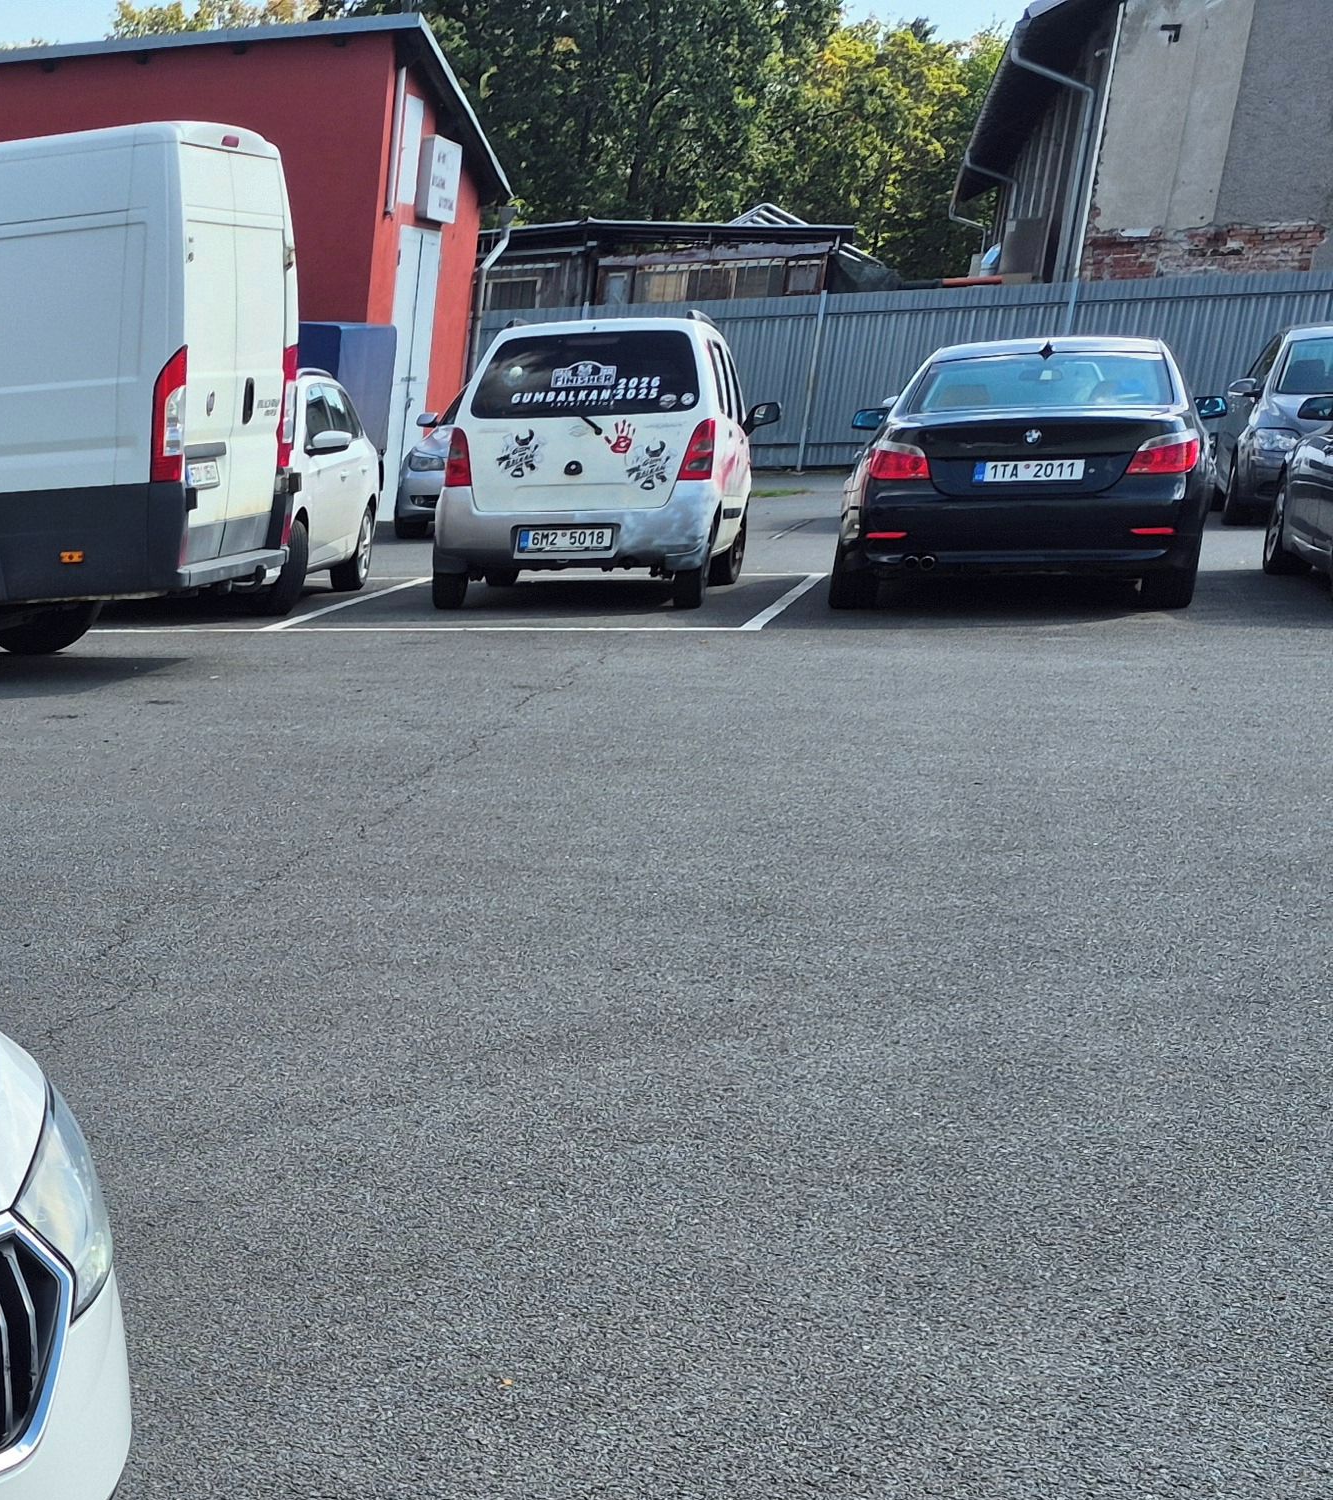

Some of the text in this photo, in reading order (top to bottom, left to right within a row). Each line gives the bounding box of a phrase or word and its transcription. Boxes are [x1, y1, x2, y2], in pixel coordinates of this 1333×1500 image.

[616, 376, 660, 389] 2026
[511, 389, 611, 404] GUMBALKAN
[991, 462, 1075, 479] 1TA 2011
[532, 531, 604, 546] 6M2 5018
